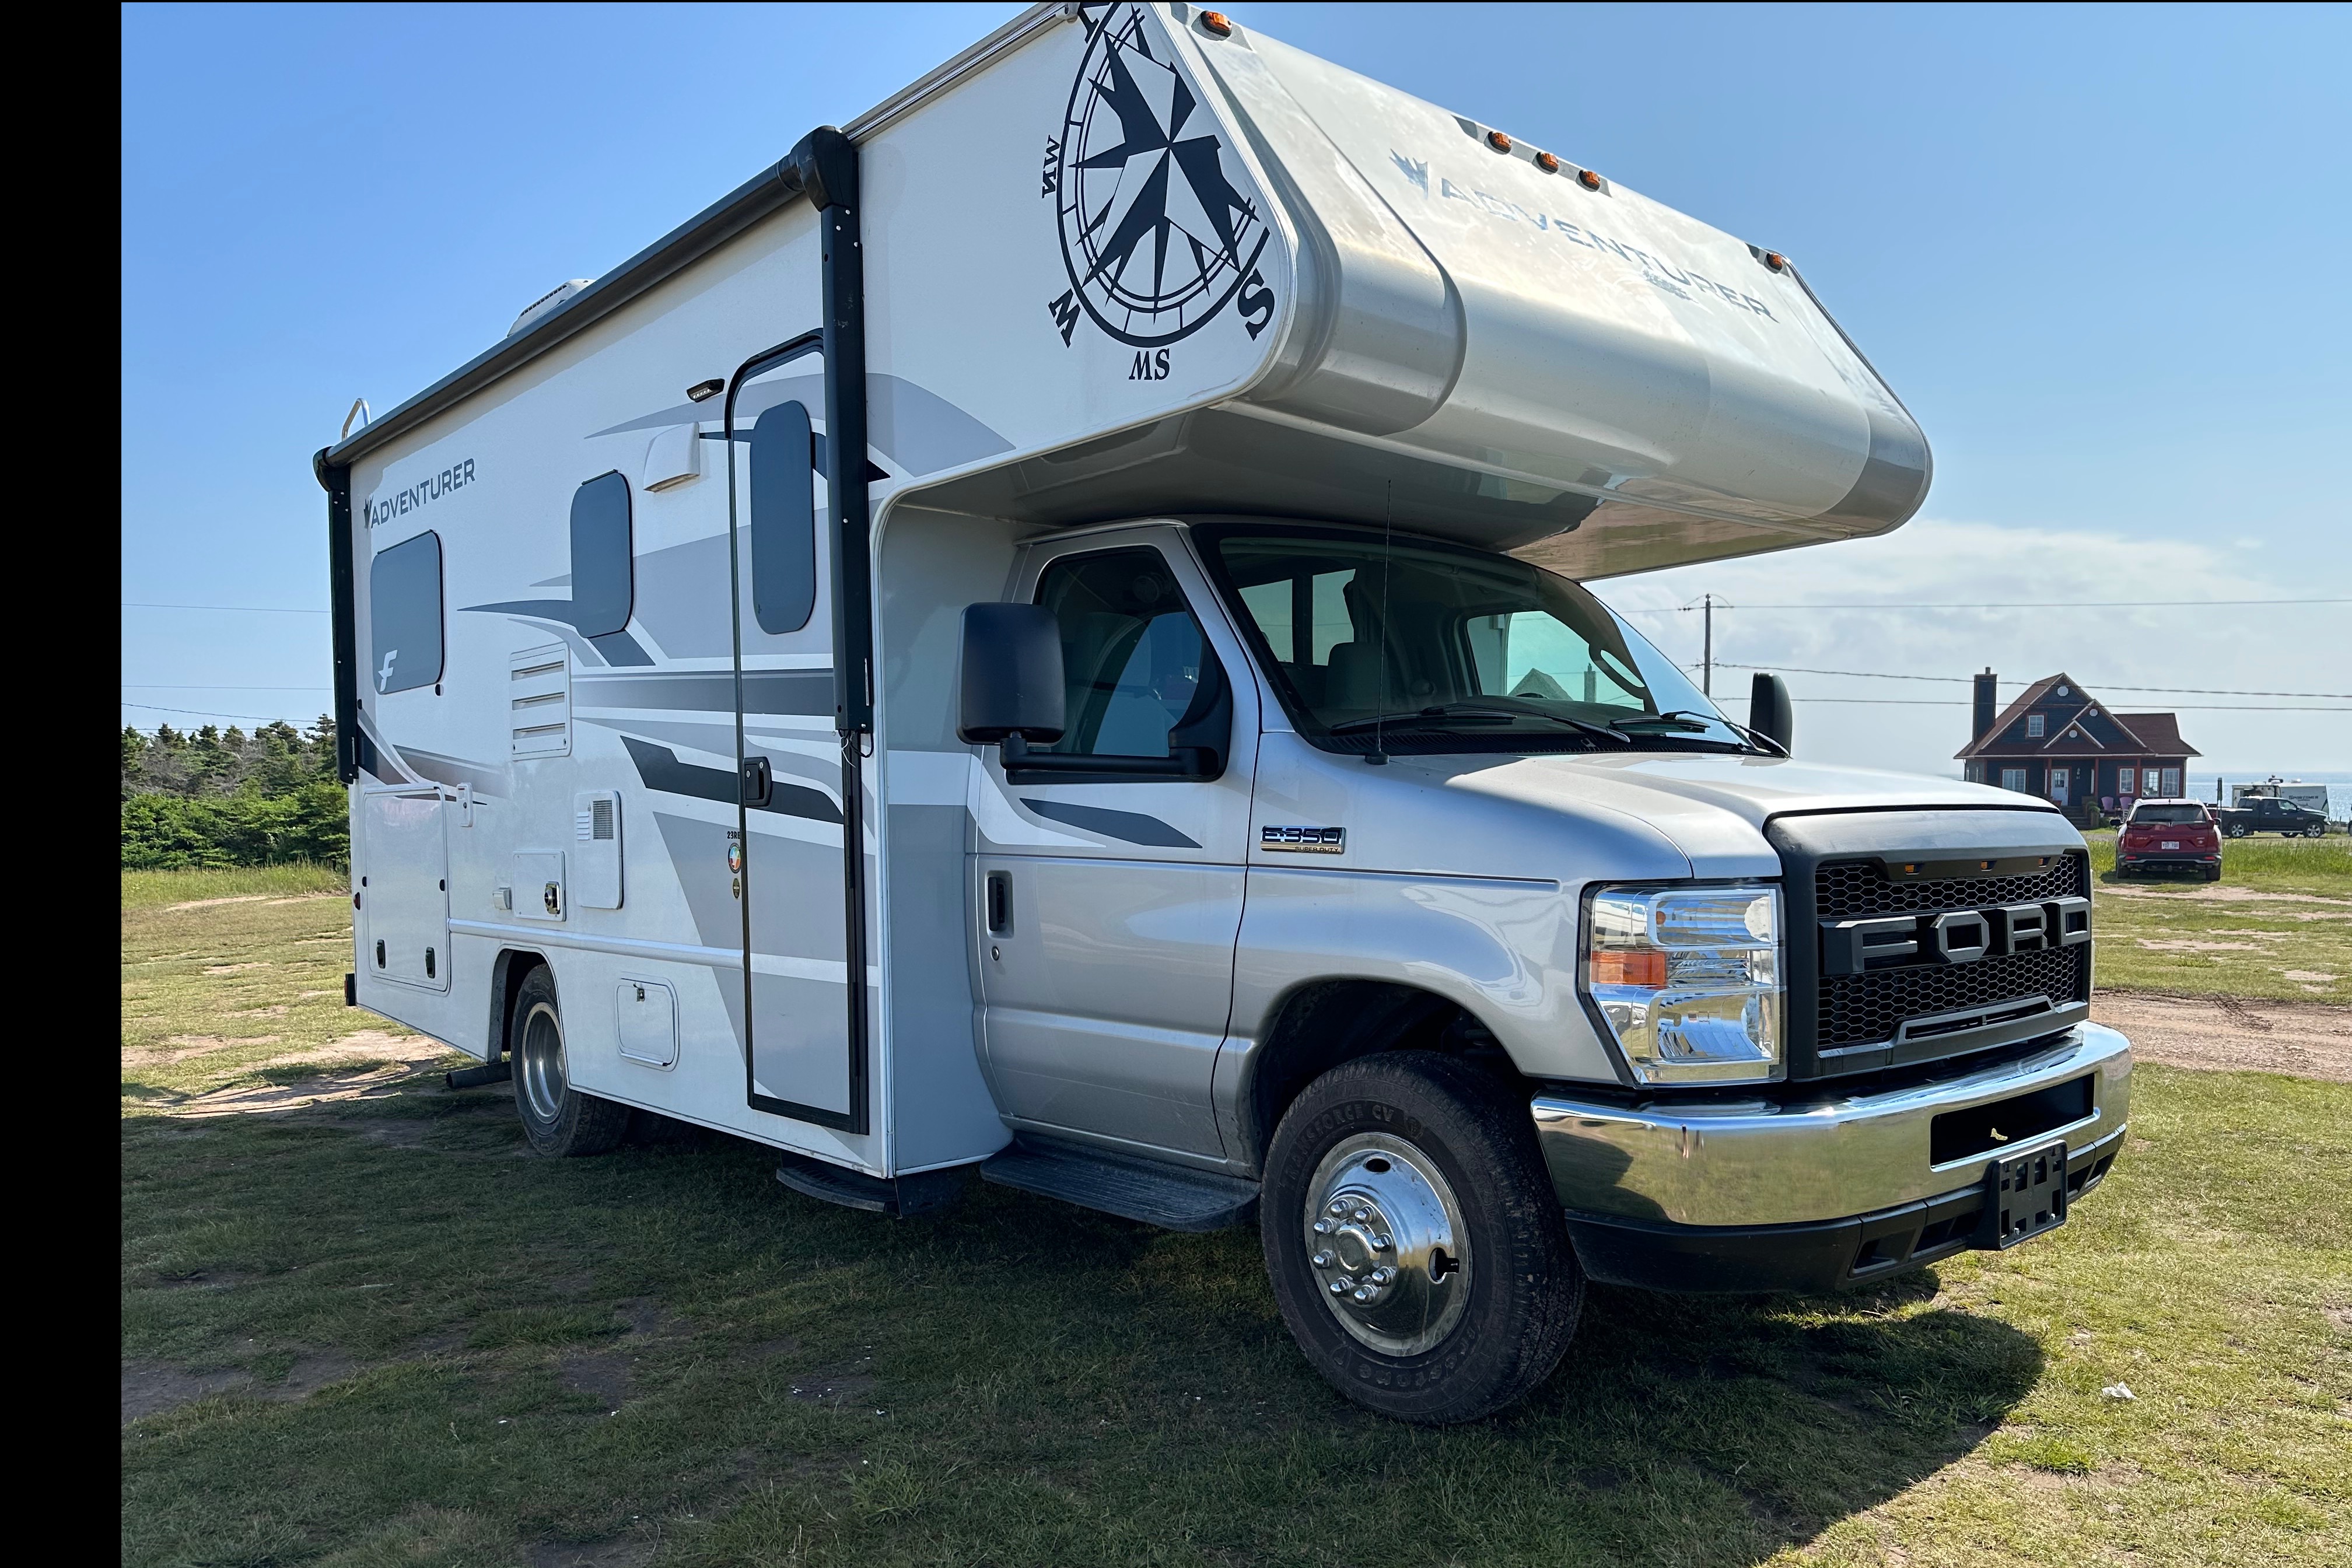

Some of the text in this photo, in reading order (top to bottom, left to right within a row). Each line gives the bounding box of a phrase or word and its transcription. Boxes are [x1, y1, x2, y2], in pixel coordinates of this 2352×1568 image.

[1441, 177, 1780, 323] ADVENTURER
[1237, 268, 1275, 341] S
[370, 458, 476, 528] ADVENTURER
[1818, 897, 2091, 976] FORD
[1371, 1104, 1394, 1122] CV
